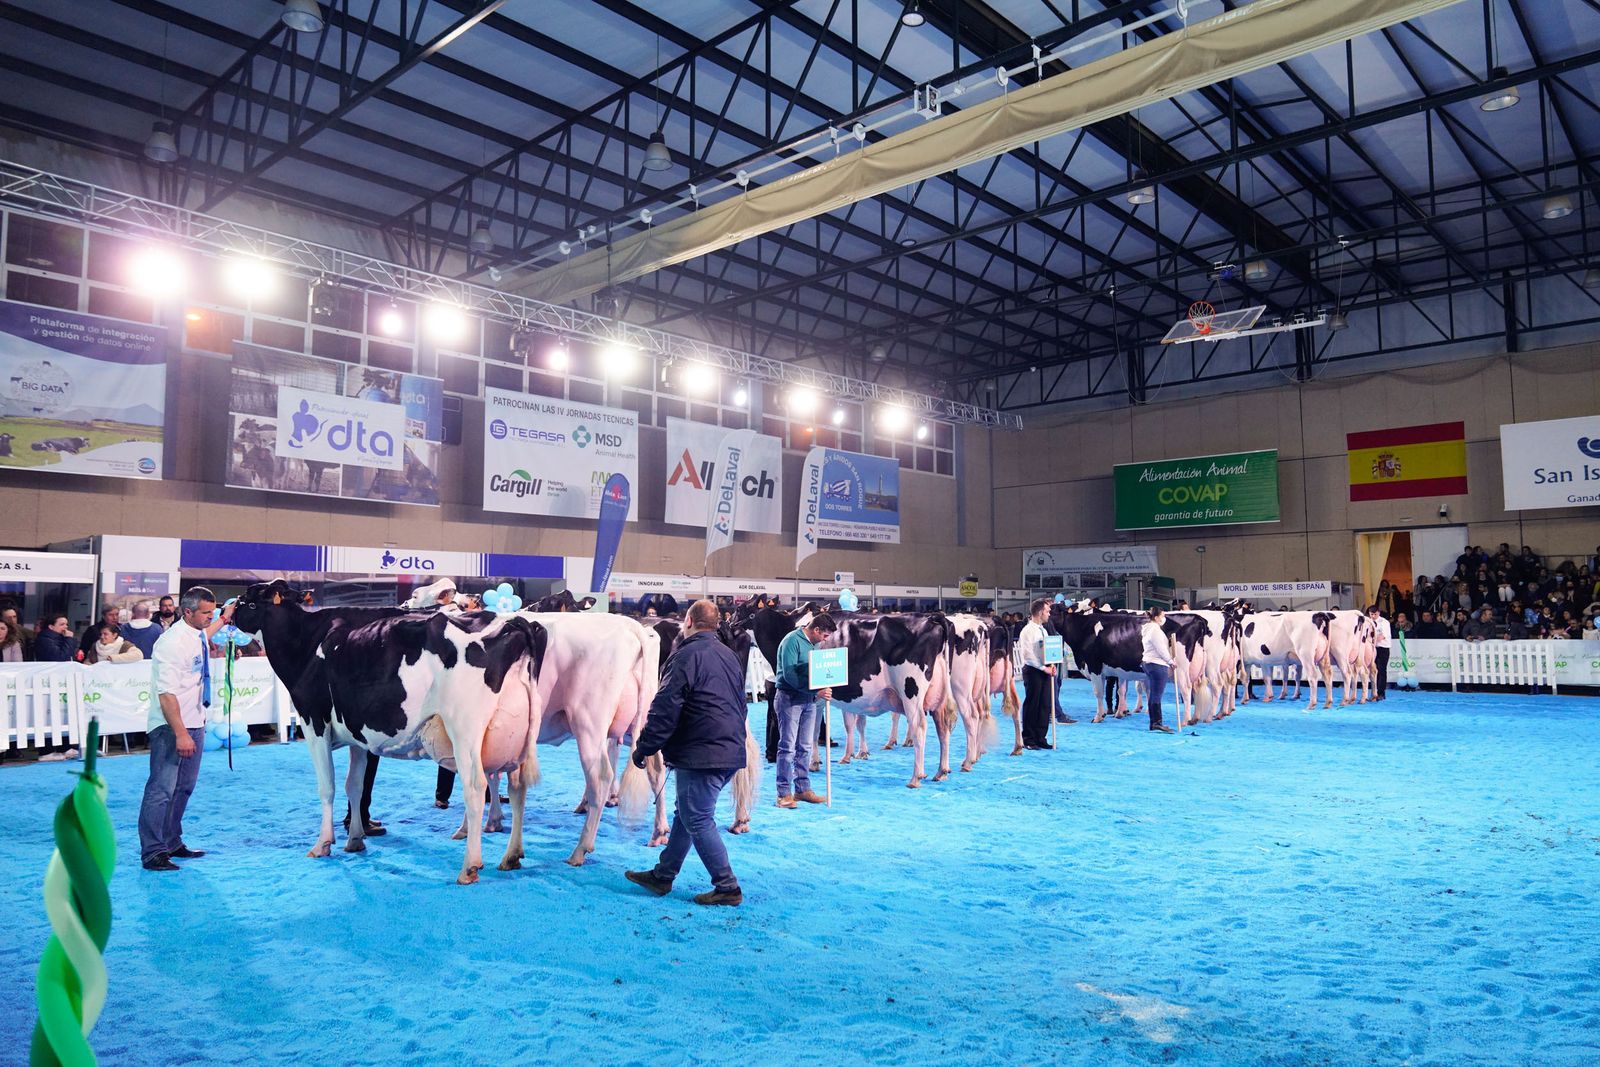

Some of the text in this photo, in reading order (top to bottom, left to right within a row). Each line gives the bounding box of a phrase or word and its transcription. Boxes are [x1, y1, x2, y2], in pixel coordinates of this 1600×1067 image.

[30, 315, 155, 342] Plataforma de integración
[42, 328, 80, 341] gestión
[82, 333, 95, 343] de
[97, 337, 122, 347] datos
[124, 341, 151, 352] online
[21, 381, 64, 394] BIG DATA
[492, 396, 634, 426] PATROCINAN LAS IV JORNADAS TECNICAS
[327, 419, 394, 457] dta
[509, 426, 566, 443] TEGASA
[595, 432, 622, 447] MSD
[668, 447, 775, 499] Allch
[717, 446, 742, 515] DeLaval
[1139, 459, 1248, 483] Alimentación Animal
[1534, 468, 1573, 485] San
[490, 474, 542, 498] Cargill
[806, 464, 820, 525] DeLaval
[1158, 483, 1228, 505] COVAP
[1567, 493, 1600, 503] Ganad
[1192, 510, 1203, 520] de
[1204, 508, 1233, 522] futuro
[399, 556, 435, 570] dta
[1101, 550, 1135, 564] GEA
[1223, 581, 1326, 592] WORLD WIDE SIRES ESPAÑA
[1389, 661, 1416, 669] COAP
